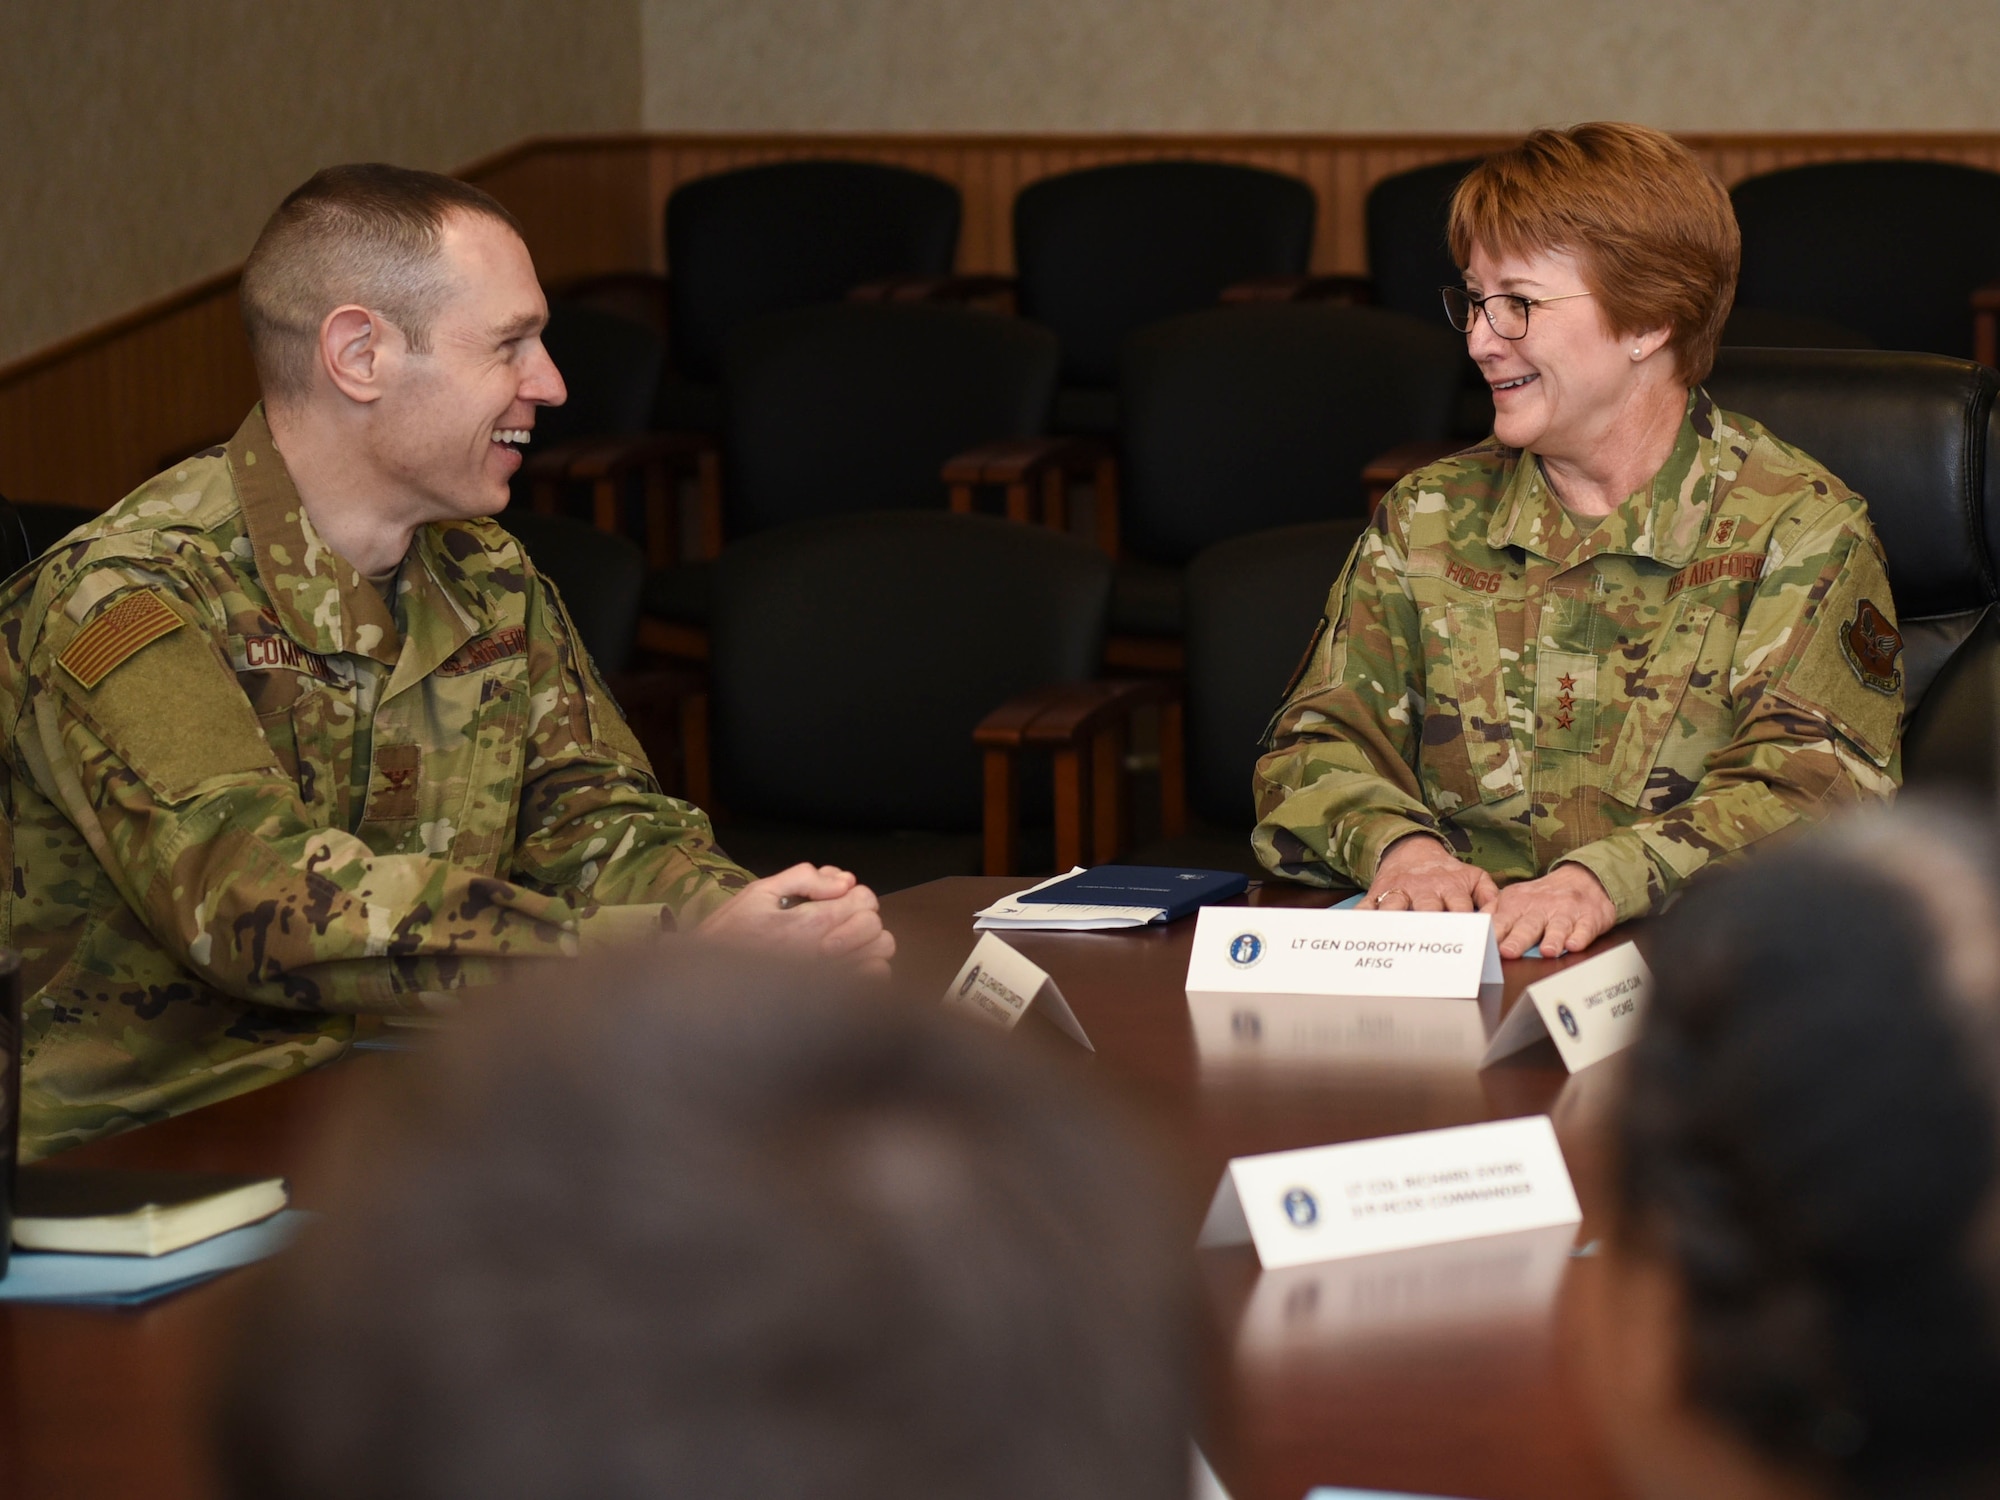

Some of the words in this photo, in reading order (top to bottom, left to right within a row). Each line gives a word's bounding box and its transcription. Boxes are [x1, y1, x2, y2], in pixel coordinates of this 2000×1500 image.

[1445, 560, 1502, 594] HOGG
[1689, 559, 1714, 587] AIR
[1291, 939, 1308, 950] LT
[1311, 939, 1341, 951] GEN
[1344, 940, 1416, 953] DOROTHY
[1418, 943, 1464, 954] HOGG
[1354, 957, 1394, 969] AF/SG
